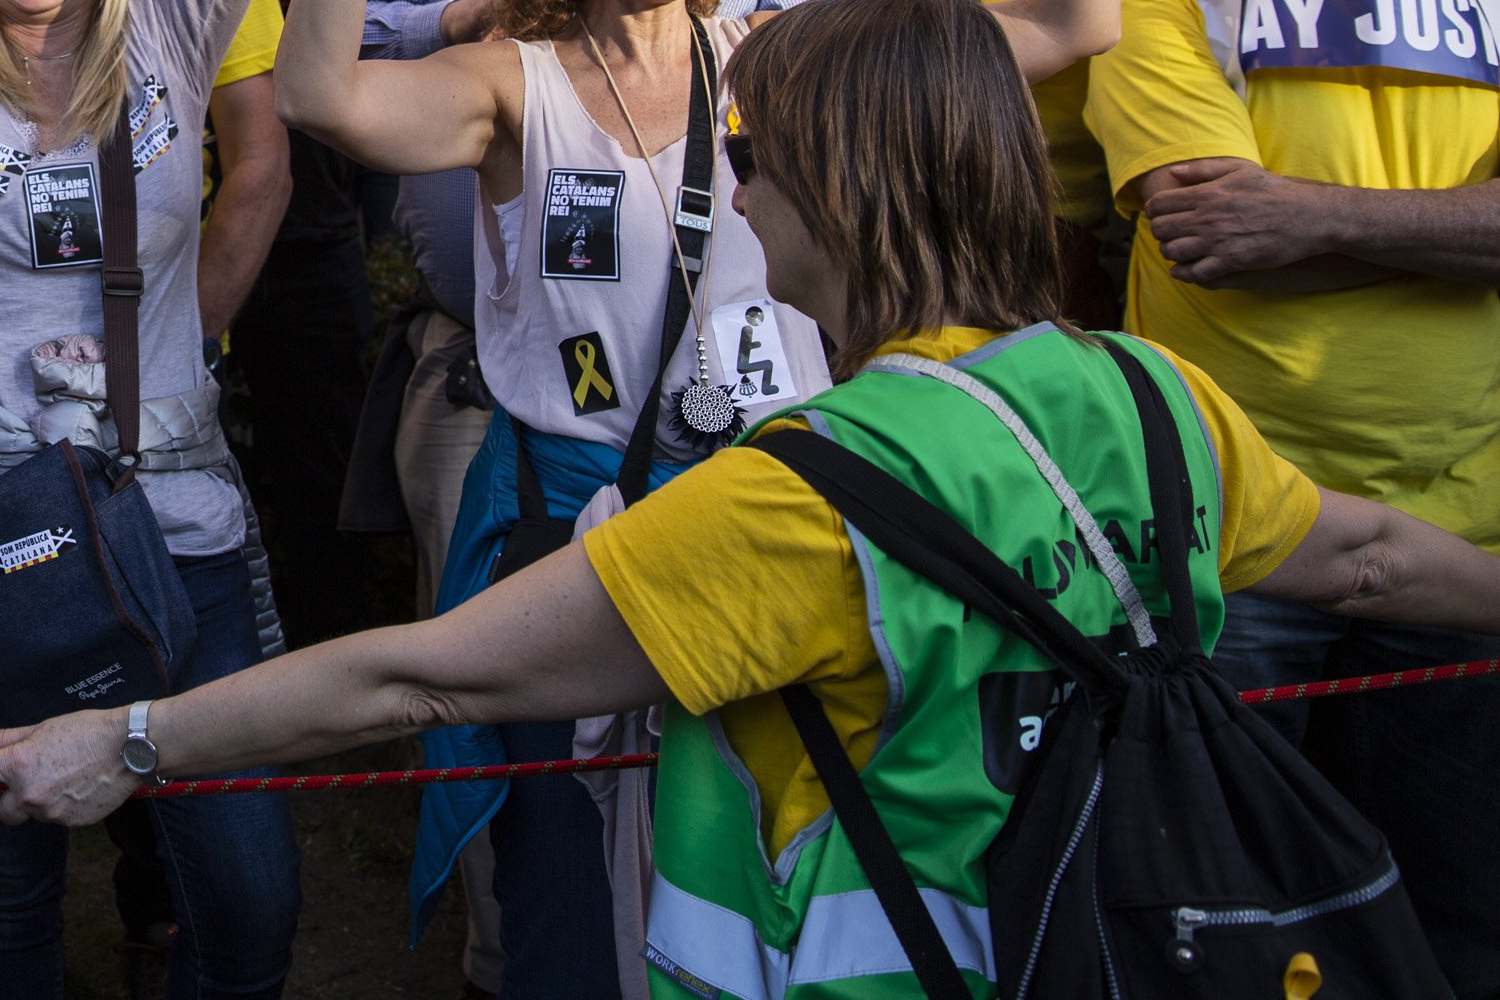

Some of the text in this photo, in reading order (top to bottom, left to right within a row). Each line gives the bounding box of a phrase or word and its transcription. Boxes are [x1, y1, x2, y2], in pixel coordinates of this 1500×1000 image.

[28, 173, 50, 185] ELS
[553, 174, 577, 185] ELS
[29, 178, 90, 194] CATALANS
[552, 185, 616, 197] CATALANS
[31, 188, 90, 204] NO TENIM
[550, 195, 612, 207] NO TENIM
[32, 202, 53, 214] REI
[549, 205, 570, 216] REI
[0, 533, 50, 556] SOM REPÚBLICA
[4, 544, 54, 567] CATALANA
[64, 662, 123, 695] BLUE ESSENCE
